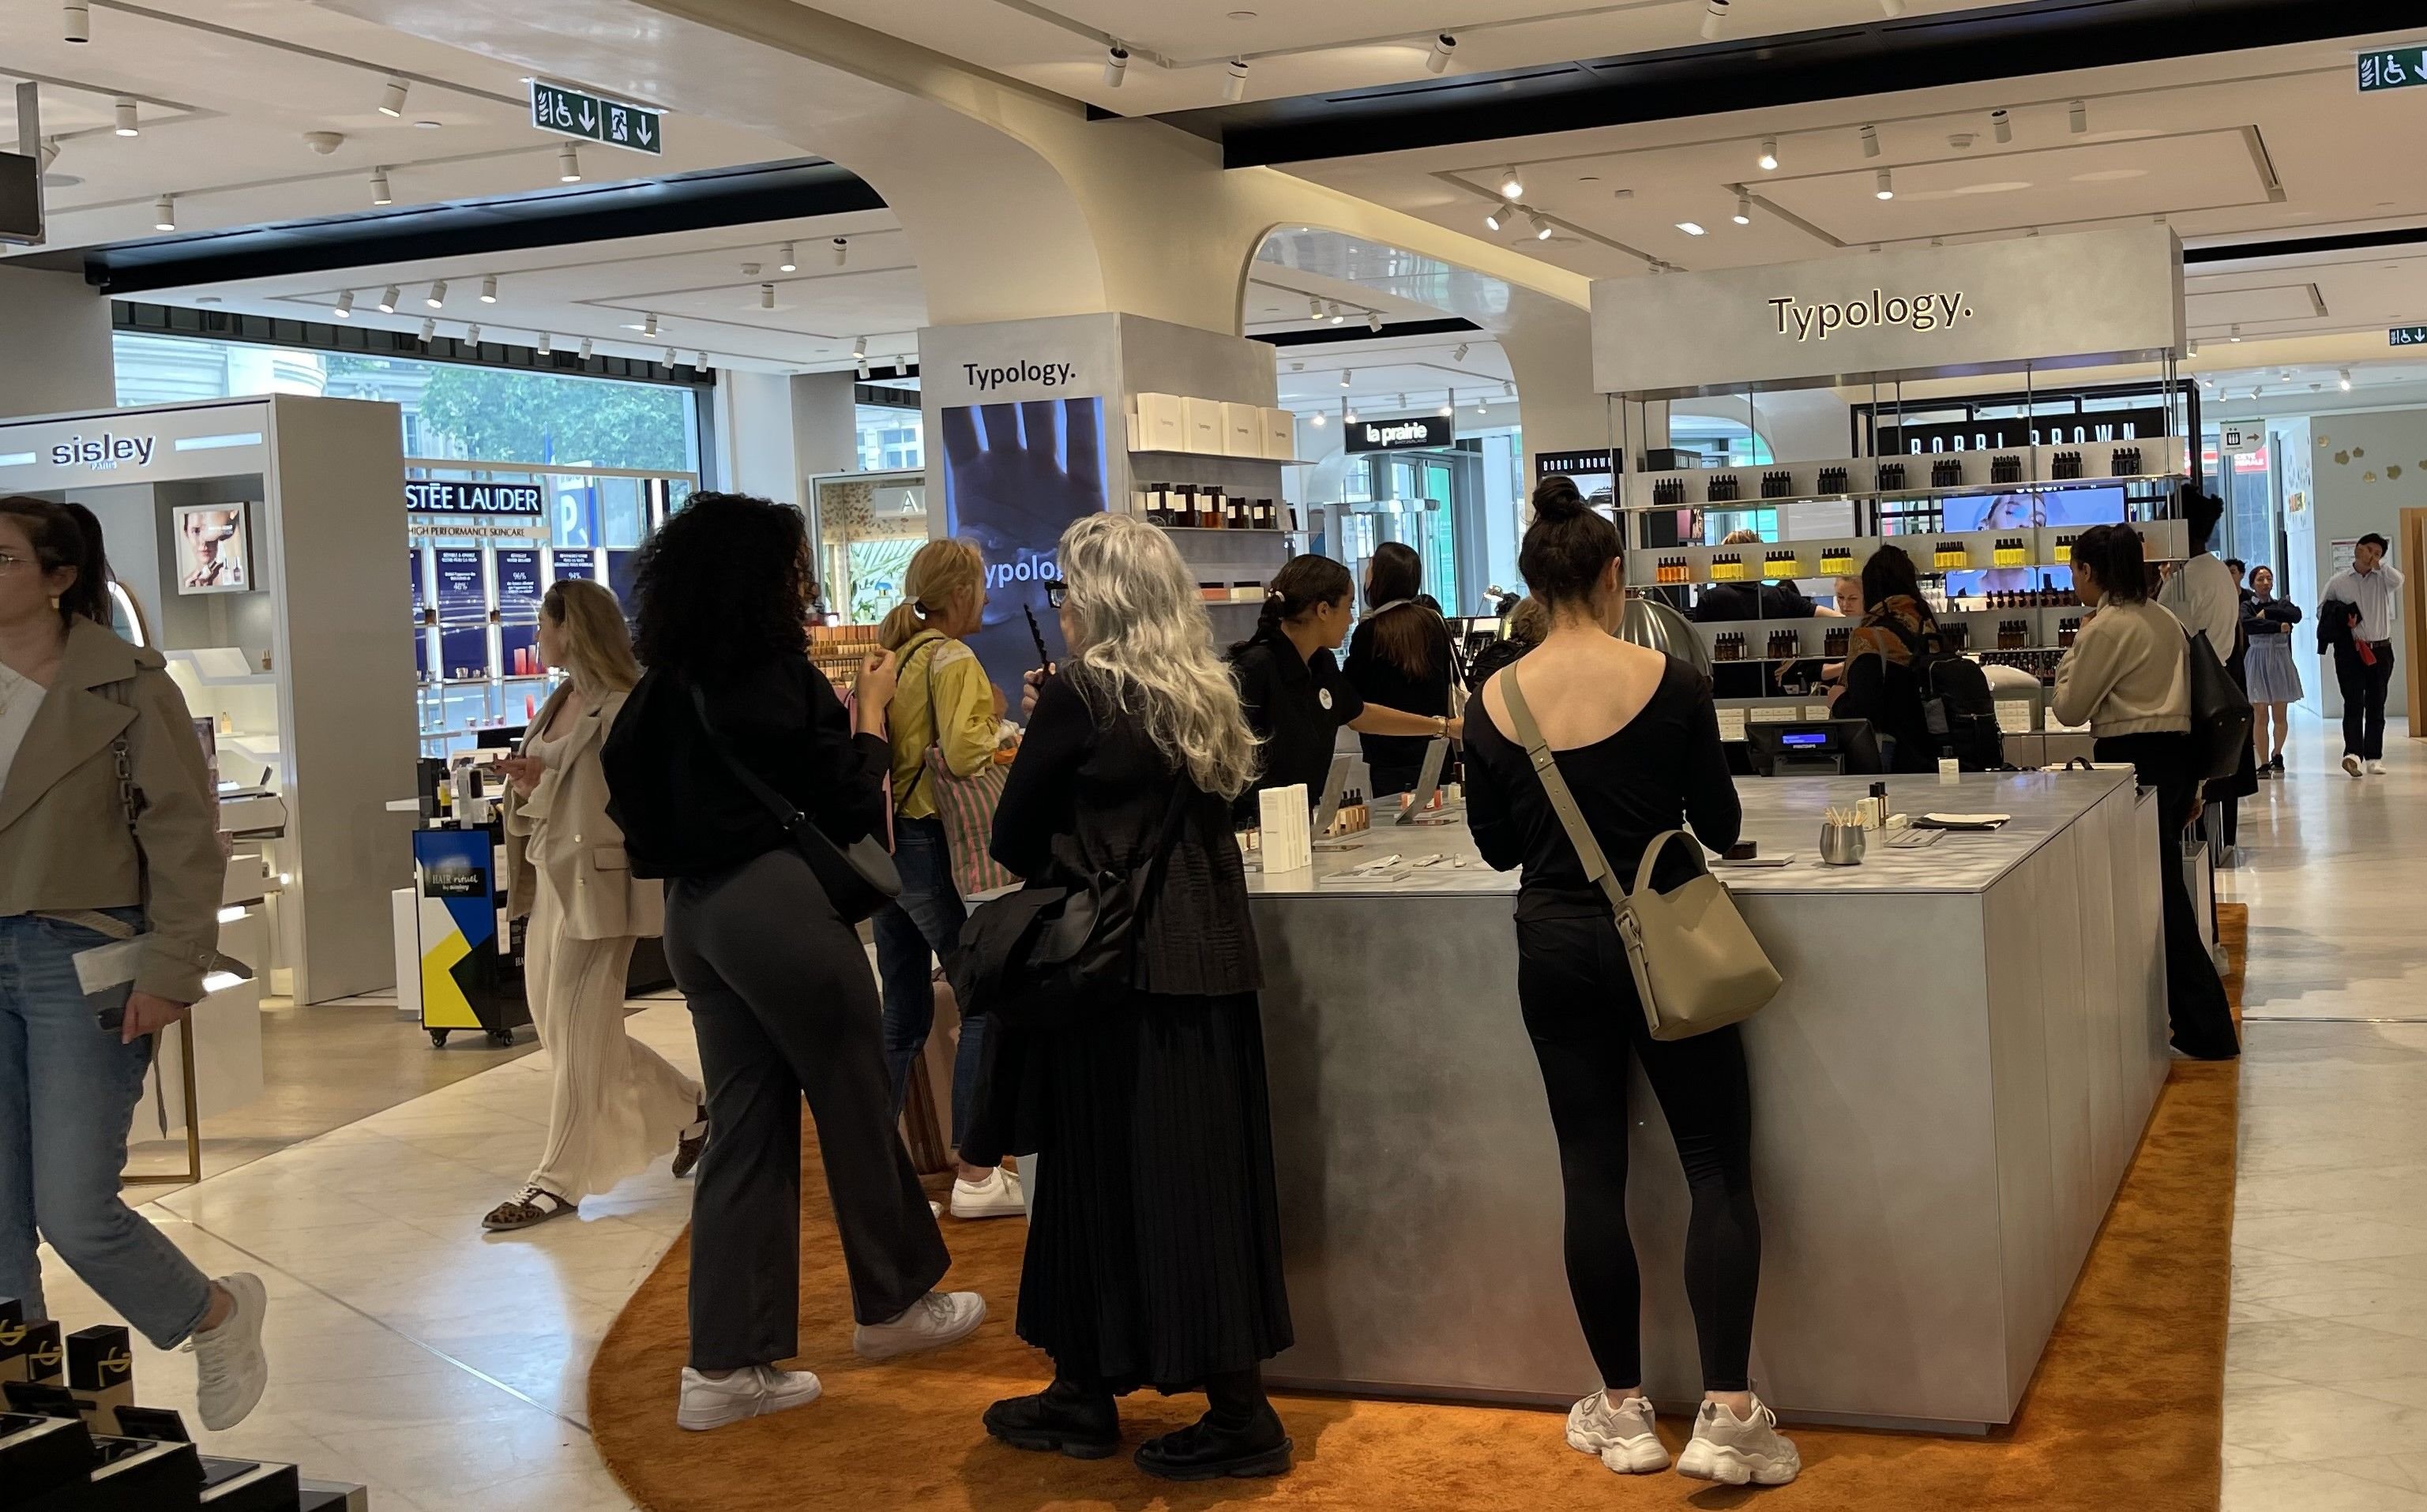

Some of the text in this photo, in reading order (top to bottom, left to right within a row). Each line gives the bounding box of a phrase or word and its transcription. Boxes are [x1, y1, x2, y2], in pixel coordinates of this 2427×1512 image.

[1768, 288, 1974, 342] Typology.
[963, 359, 1076, 391] Typology.
[1366, 422, 1428, 447] la prairie
[52, 433, 156, 467] sisley
[459, 487, 539, 512] LAUDER
[431, 527, 487, 537] PERFORMANCE
[490, 528, 525, 537] SKINCARE
[985, 554, 1064, 589] ypolo
[432, 874, 452, 884] HAIR
